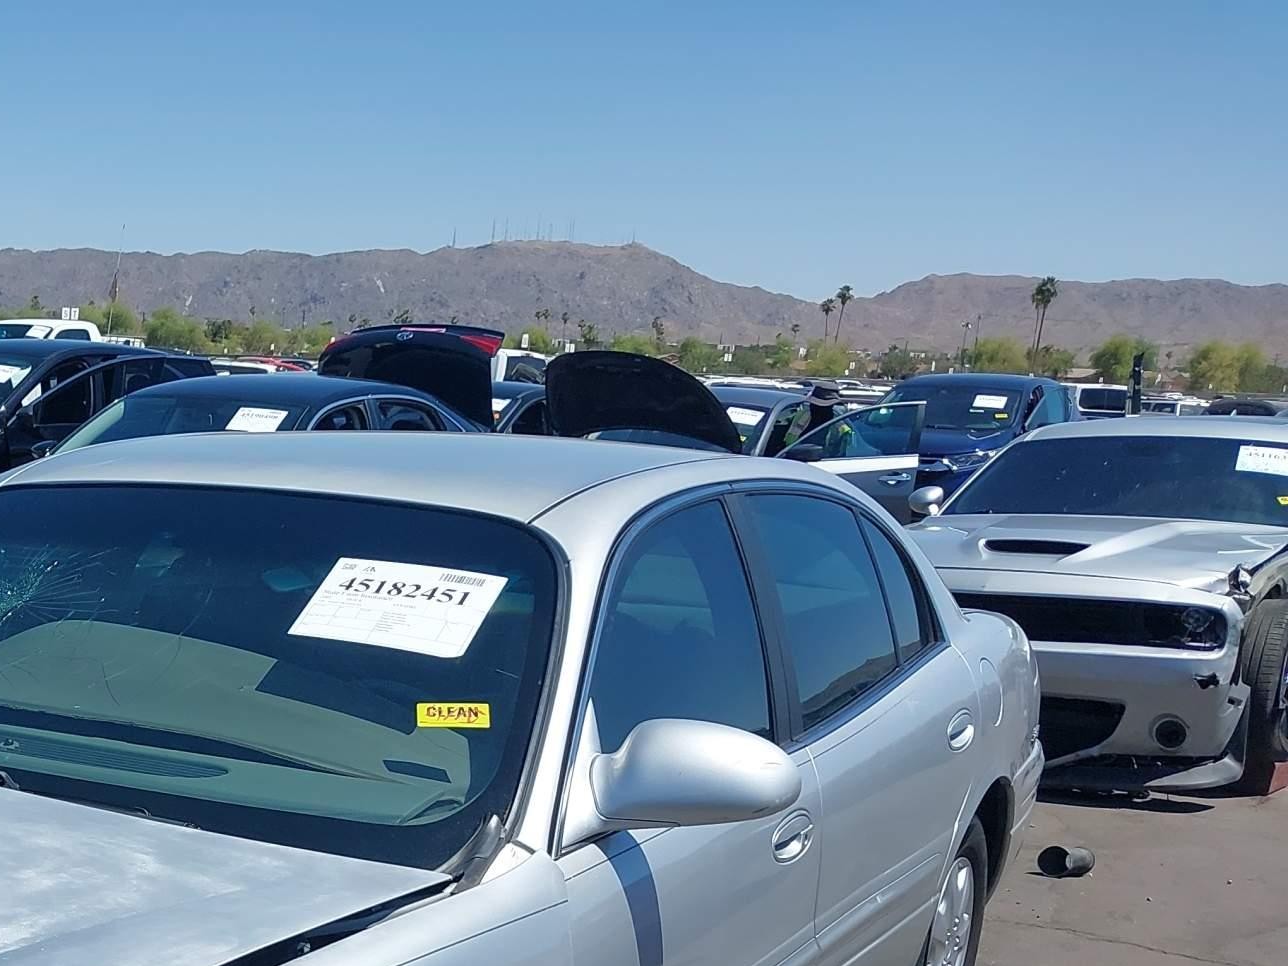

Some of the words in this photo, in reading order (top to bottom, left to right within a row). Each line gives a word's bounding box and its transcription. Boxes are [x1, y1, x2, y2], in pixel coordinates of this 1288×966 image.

[72, 310, 78, 319] T
[338, 577, 471, 606] 45182451
[426, 706, 479, 718] CLEAN
